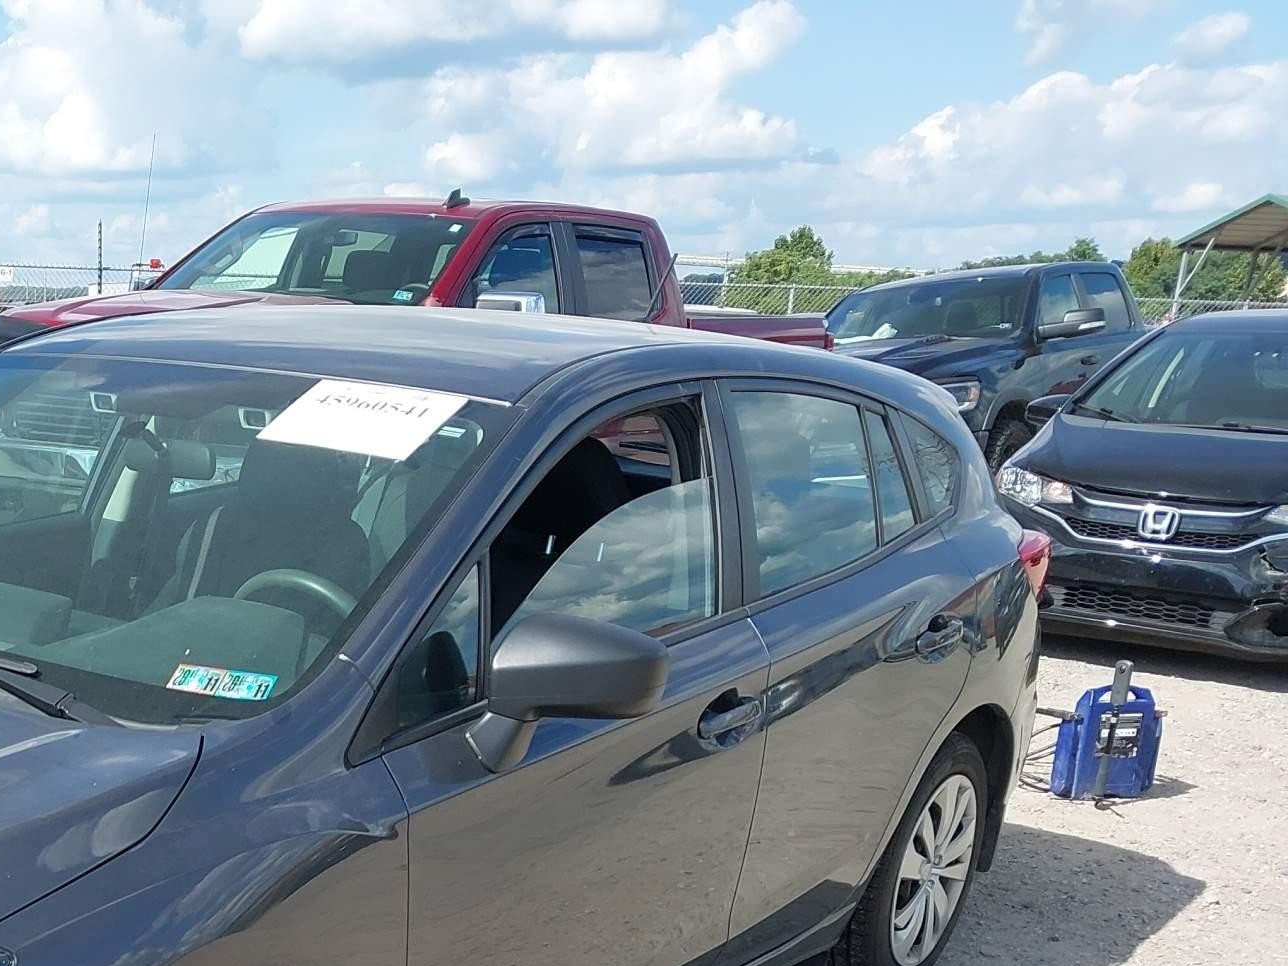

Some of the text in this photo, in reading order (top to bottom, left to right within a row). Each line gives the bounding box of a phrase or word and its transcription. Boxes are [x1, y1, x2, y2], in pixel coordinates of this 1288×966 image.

[316, 394, 430, 419] 45960541
[203, 675, 221, 692] 11
[253, 682, 270, 699] 11
